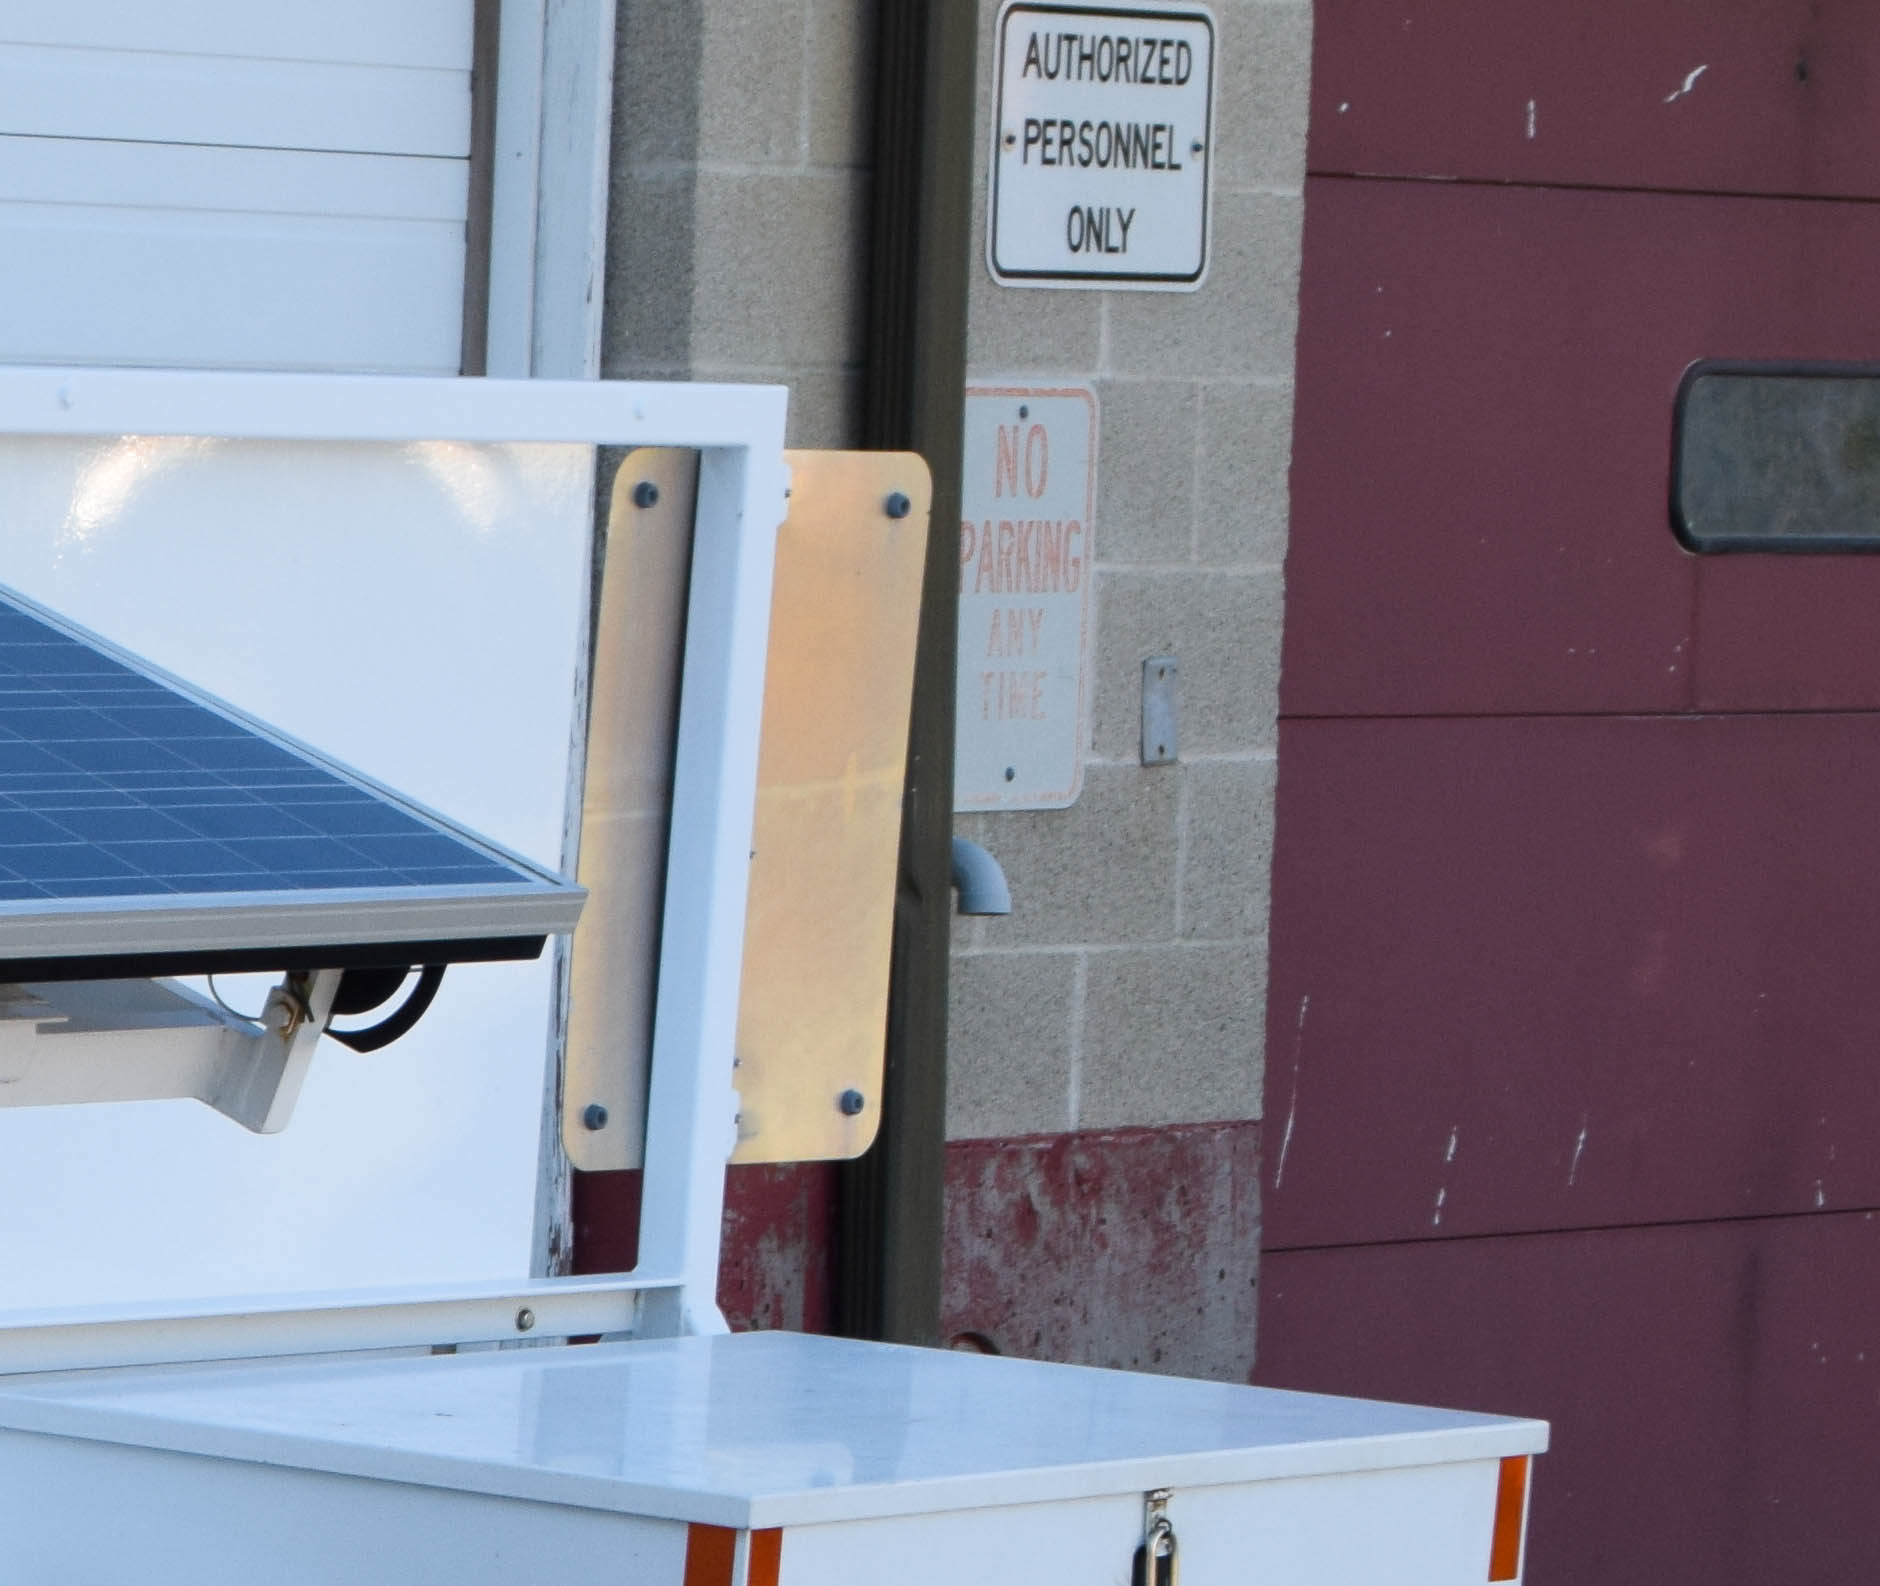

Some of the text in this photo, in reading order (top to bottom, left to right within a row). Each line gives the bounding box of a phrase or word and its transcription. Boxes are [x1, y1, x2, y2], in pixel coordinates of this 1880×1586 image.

[1022, 32, 1193, 88] AUTHORIZED
[1021, 117, 1183, 173] PERSONNEL
[1066, 205, 1135, 255] ONLY
[994, 423, 1050, 499] NO
[959, 519, 1082, 595] PARKING
[986, 608, 1044, 658] ANY
[979, 671, 1047, 721] TIME
